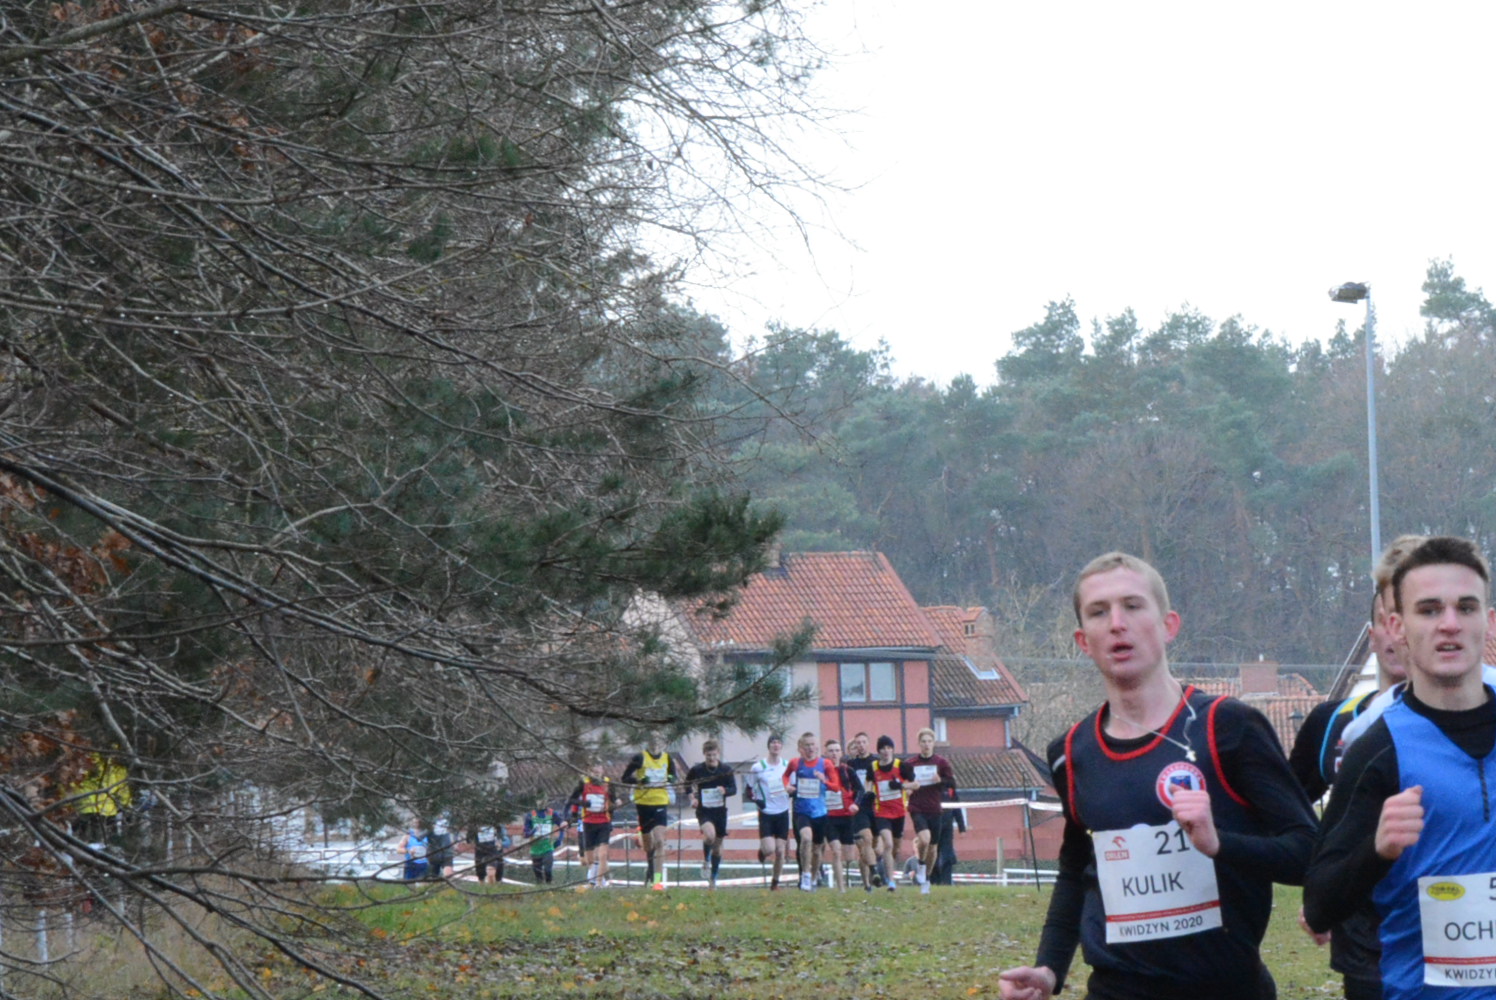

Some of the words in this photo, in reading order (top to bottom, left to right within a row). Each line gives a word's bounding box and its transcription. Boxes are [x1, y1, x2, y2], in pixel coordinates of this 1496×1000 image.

[1154, 828, 1190, 855] 21
[1122, 871, 1184, 897] KULIK
[1120, 921, 1170, 937] KWIDZYN
[1174, 915, 1203, 930] 2020
